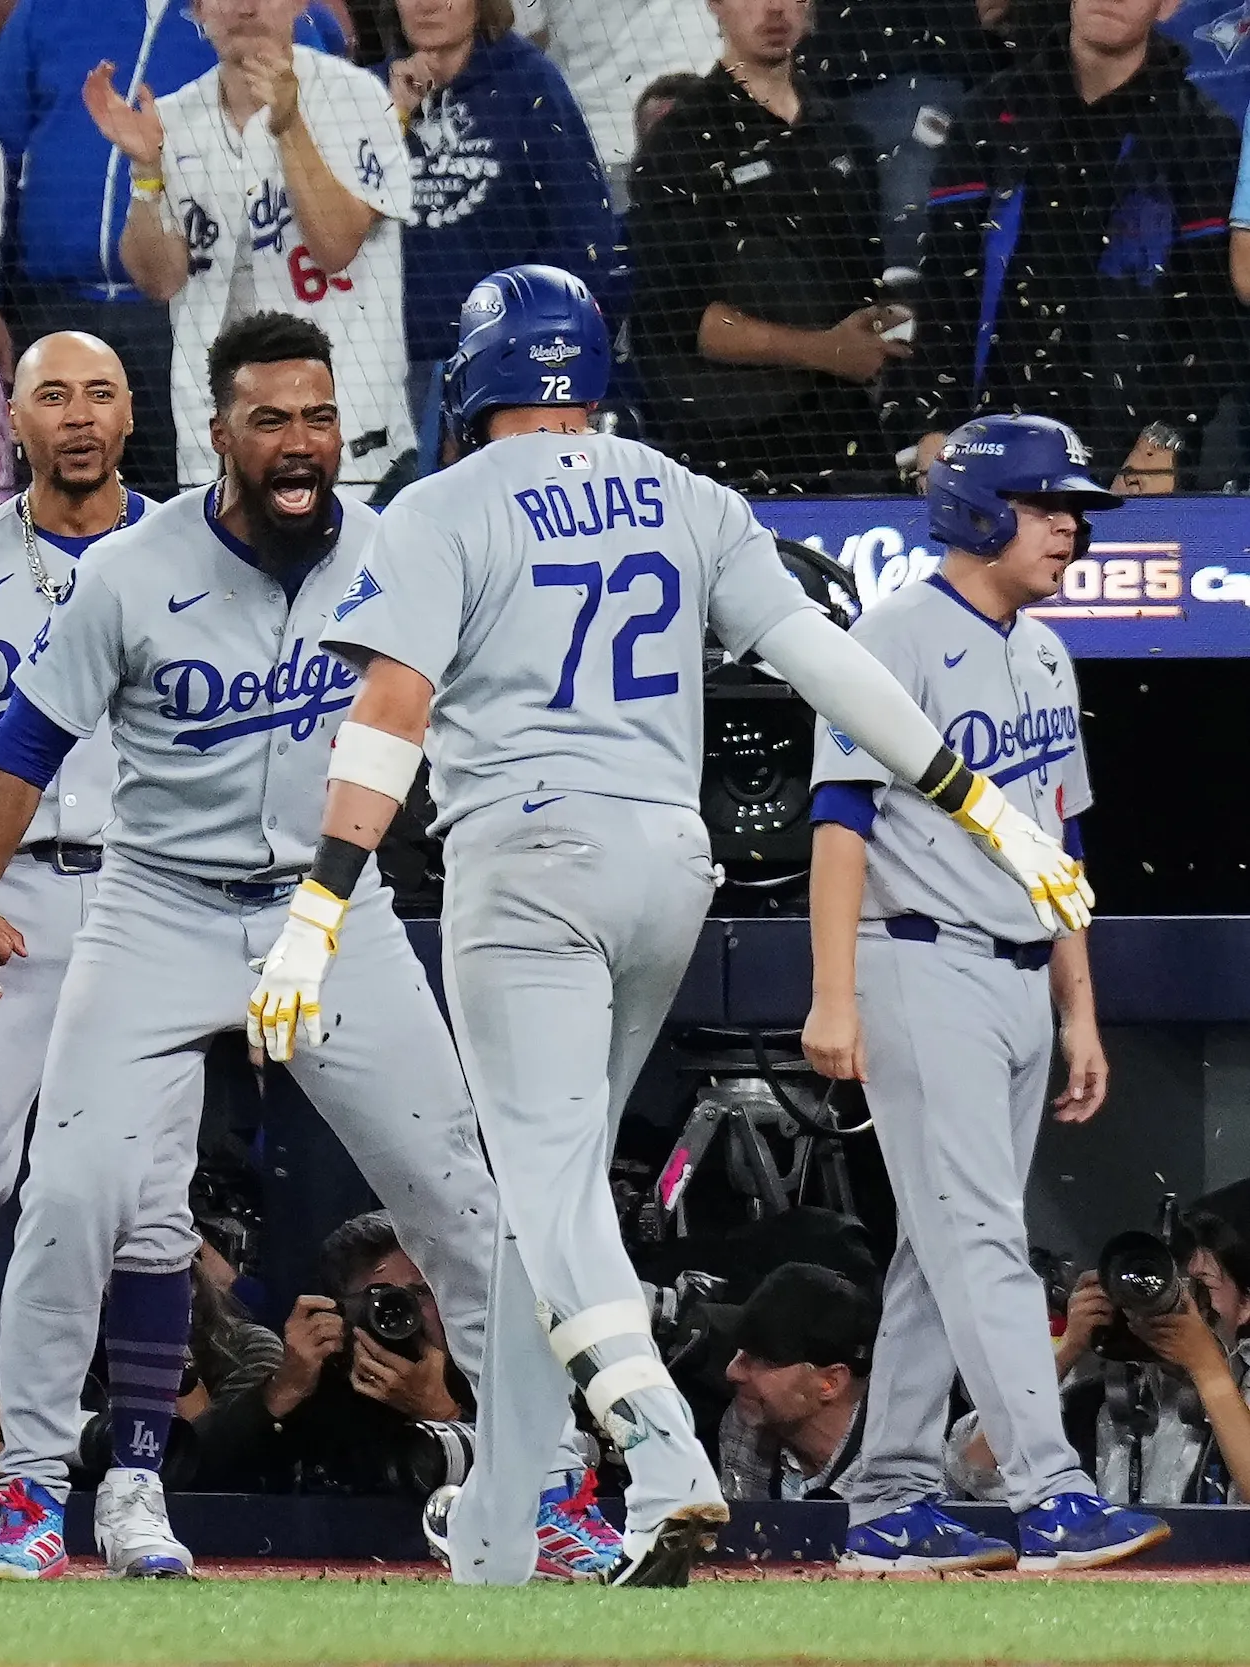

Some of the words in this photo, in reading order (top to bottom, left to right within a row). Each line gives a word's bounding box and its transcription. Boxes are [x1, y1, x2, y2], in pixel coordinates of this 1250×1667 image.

[541, 375, 571, 400] 72
[514, 477, 664, 541] ROJAS
[1062, 559, 1183, 600] 025
[532, 551, 681, 709] 72
[943, 691, 1077, 786] Dodgers
[129, 1420, 160, 1458] LA
